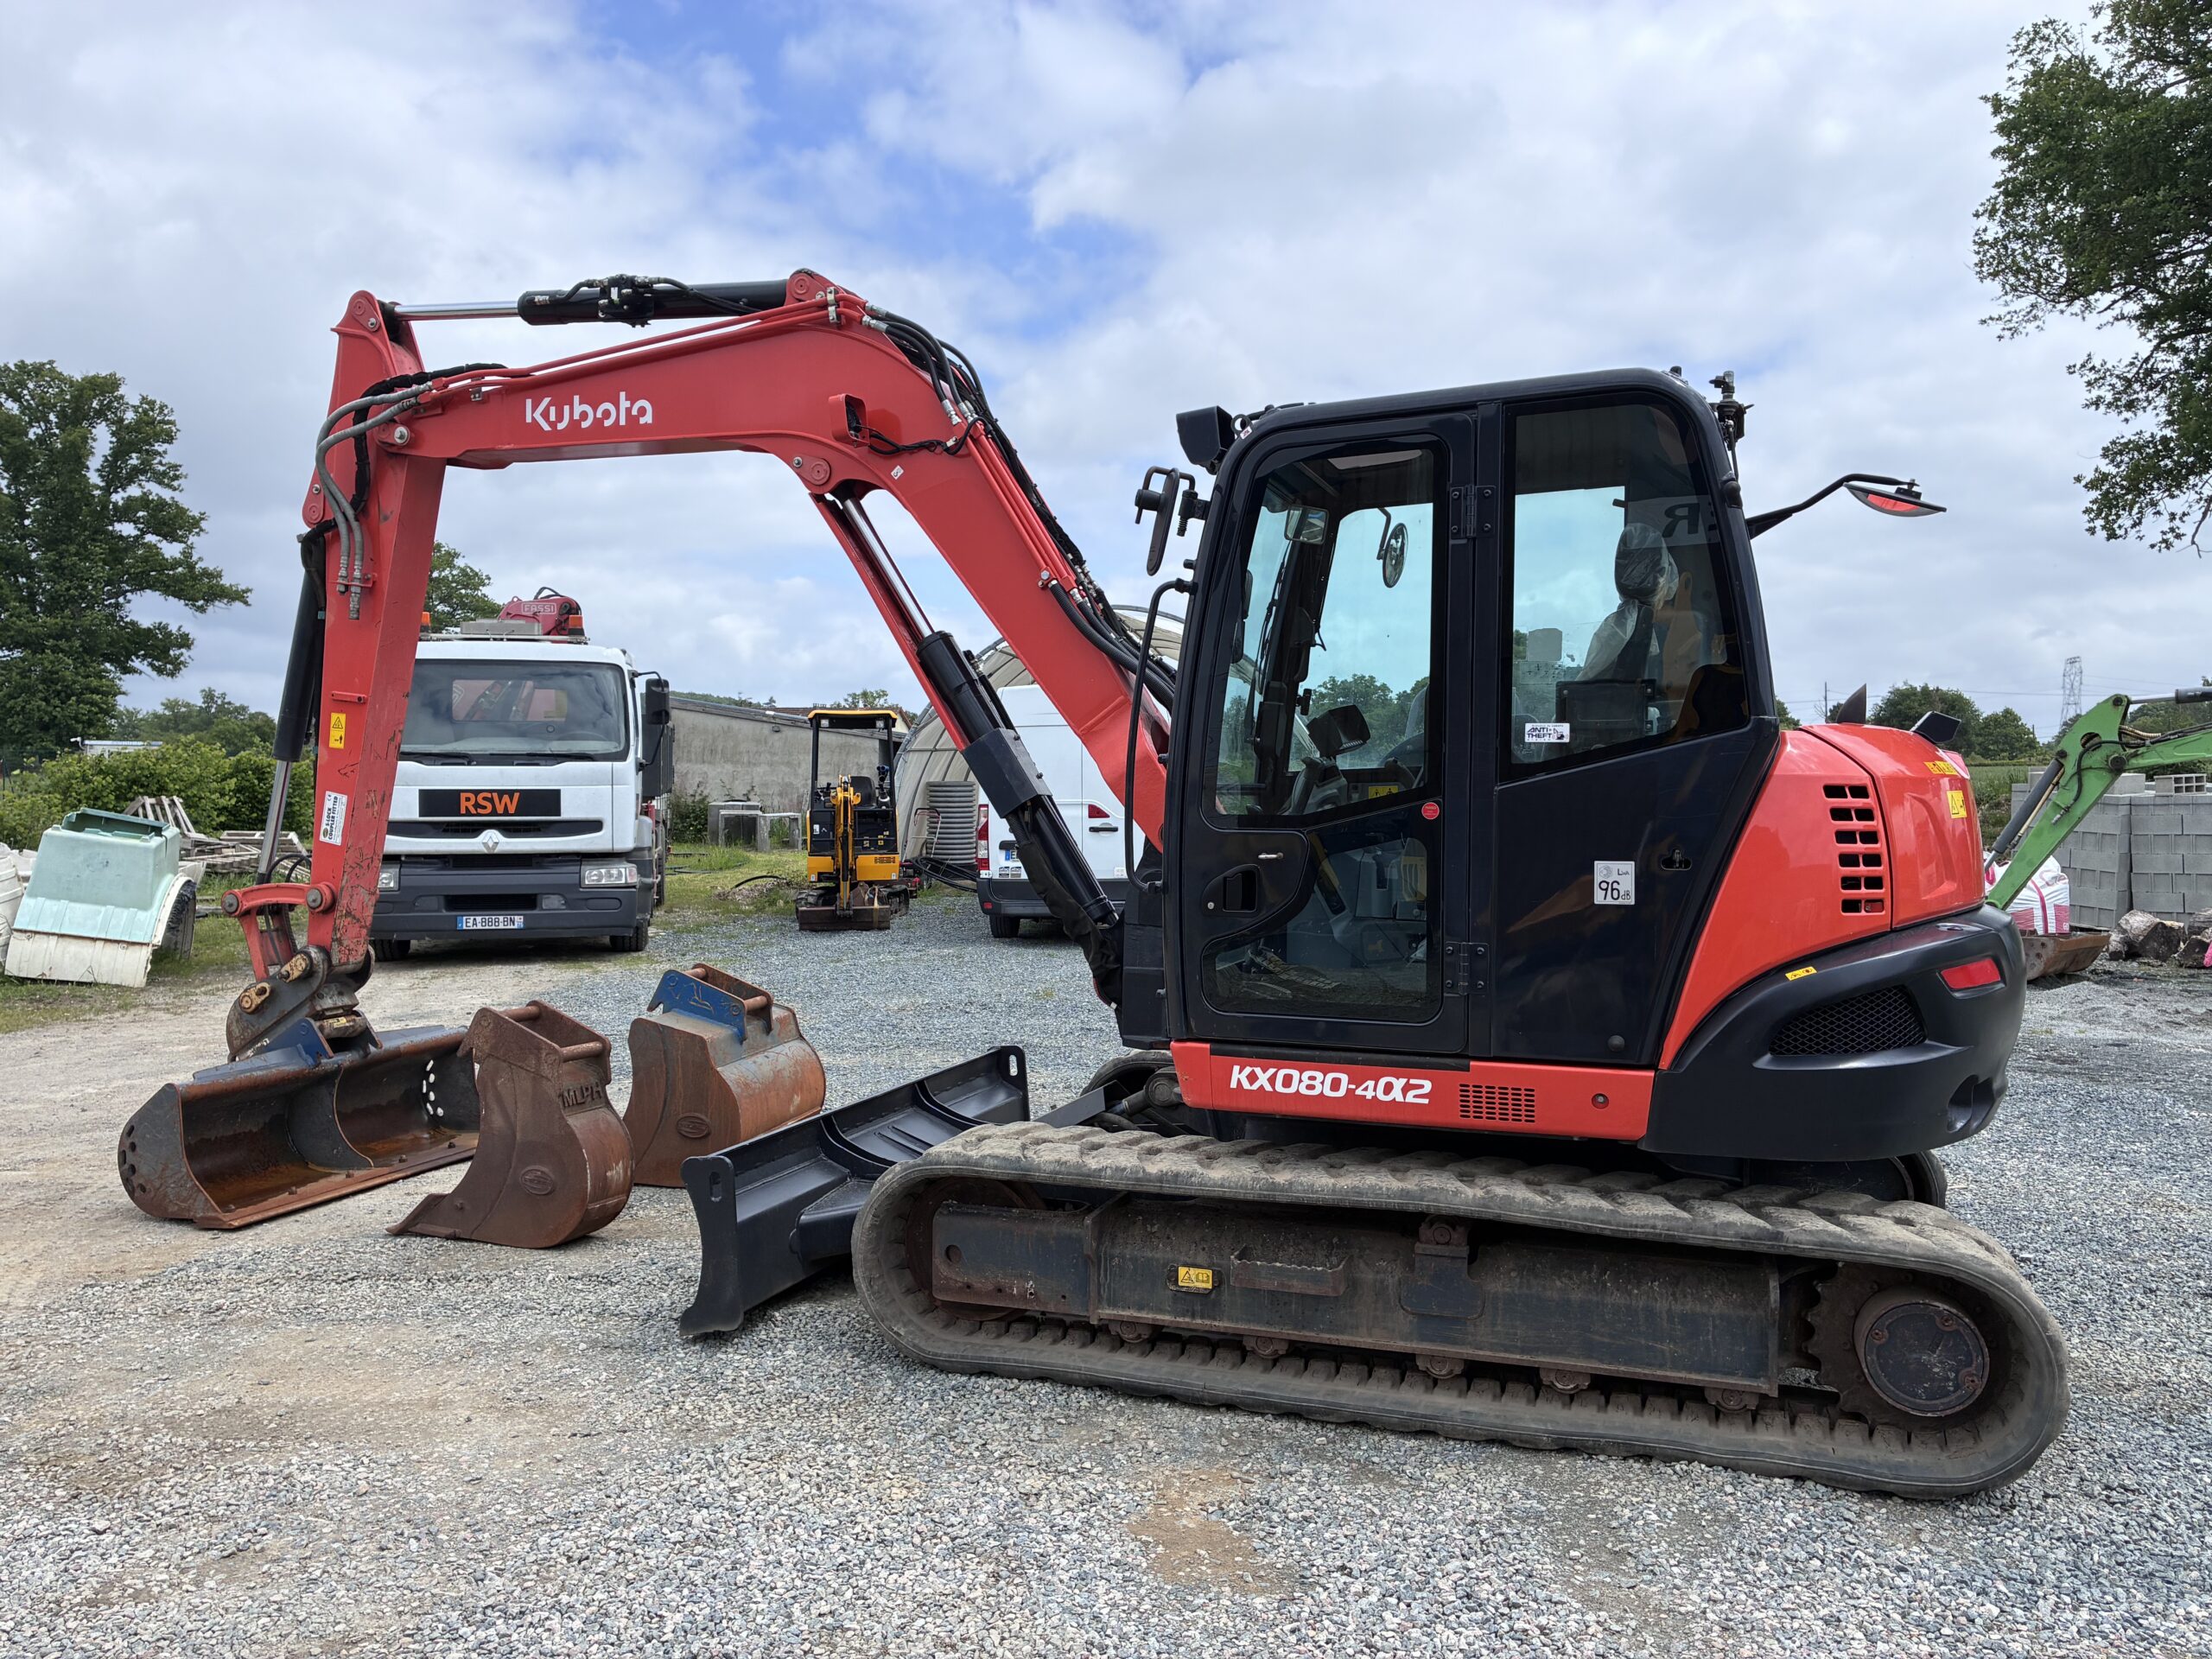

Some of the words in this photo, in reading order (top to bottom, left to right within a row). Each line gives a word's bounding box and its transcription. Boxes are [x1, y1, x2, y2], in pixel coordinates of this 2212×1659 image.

[525, 391, 652, 430] Kubota
[460, 792, 520, 814] RSW
[1599, 880, 1620, 900] 96
[1621, 890, 1631, 900] dB
[465, 917, 516, 928] EA-888-BN
